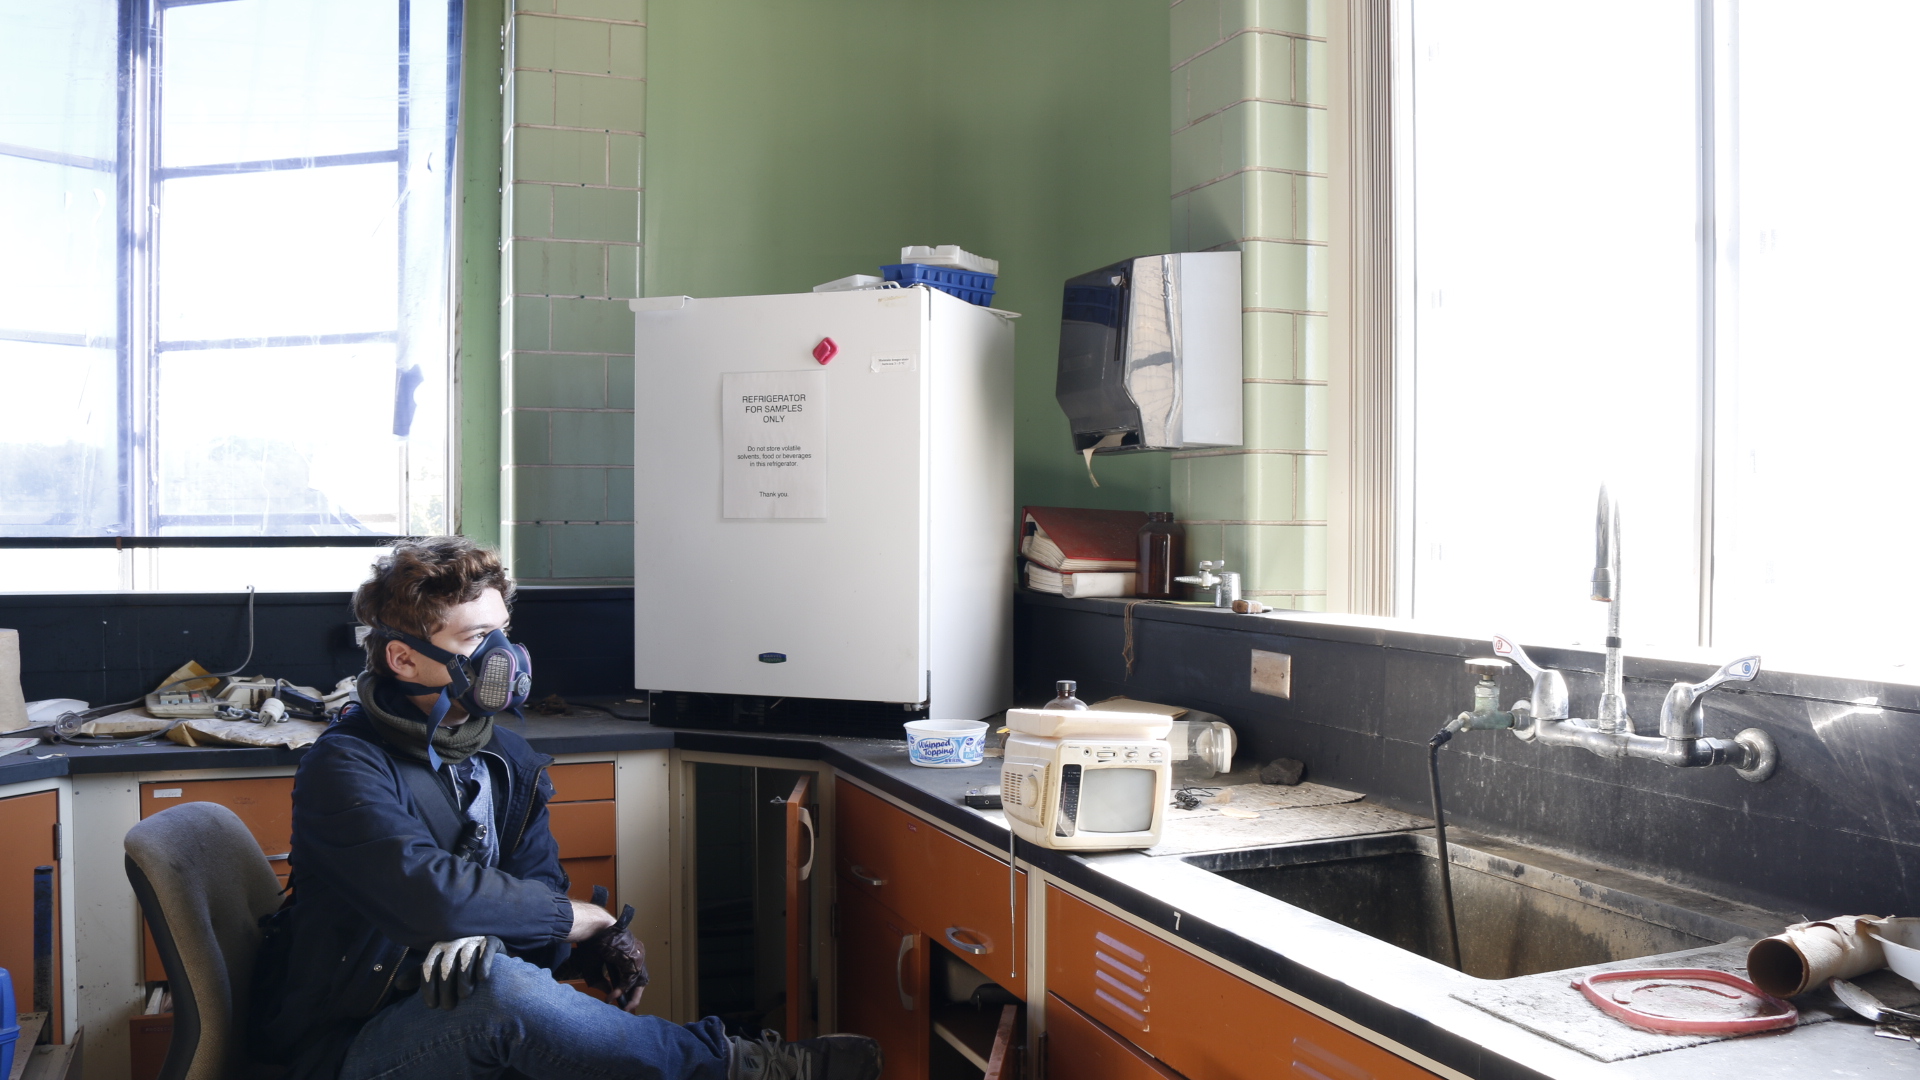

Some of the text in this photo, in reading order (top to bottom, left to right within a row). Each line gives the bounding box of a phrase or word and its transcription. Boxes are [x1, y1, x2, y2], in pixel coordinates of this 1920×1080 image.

[742, 394, 806, 403] REFRIGERATOR
[745, 404, 803, 413] FOR SAMPLES
[763, 415, 785, 423] ONLY
[919, 739, 950, 749] Whipped
[923, 748, 954, 756] Topping
[1173, 911, 1181, 930] 7
